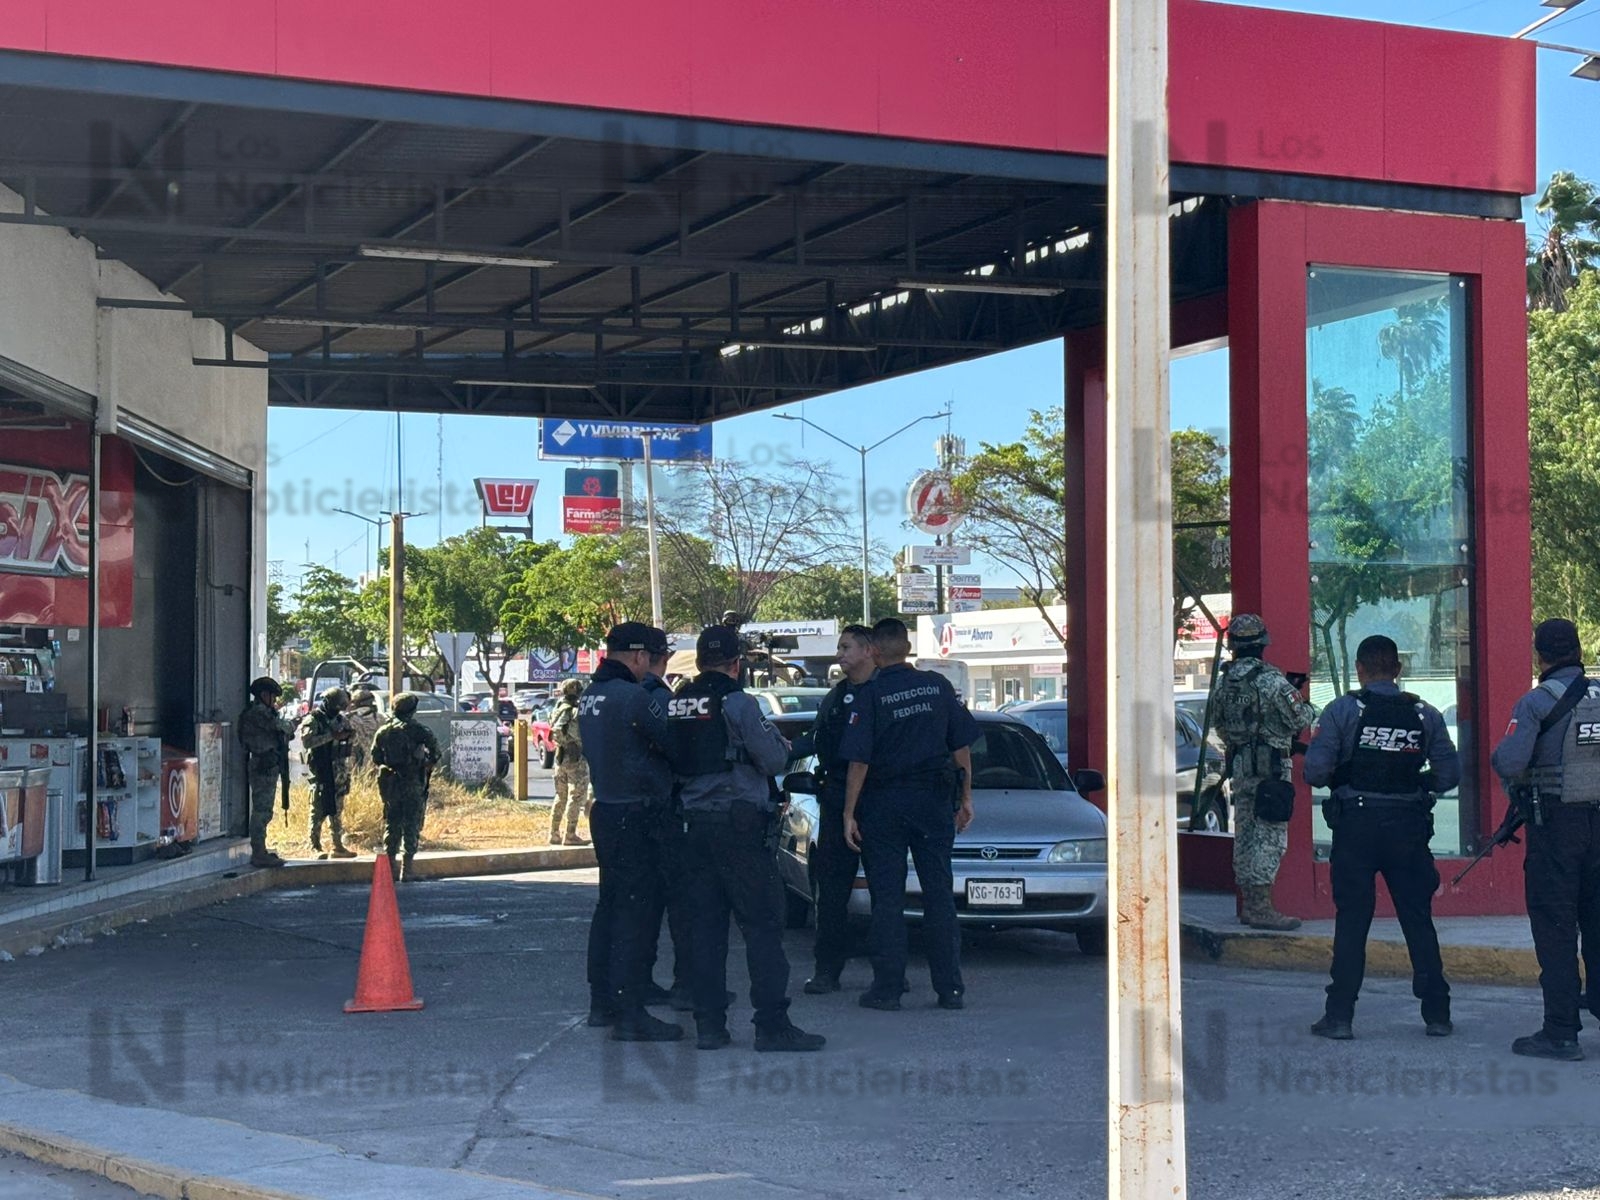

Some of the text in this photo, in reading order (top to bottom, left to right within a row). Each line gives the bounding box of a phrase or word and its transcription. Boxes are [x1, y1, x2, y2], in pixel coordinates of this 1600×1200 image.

[578, 424, 589, 437] Y
[971, 627, 993, 641] Ahorro
[881, 684, 940, 706] PROTECCIÓN
[668, 697, 710, 716] SSPC
[893, 702, 933, 719] FEDERAL
[1360, 726, 1422, 743] SSPC
[1359, 738, 1421, 750] FEDERAL
[969, 886, 1022, 900] VSG-763-D
